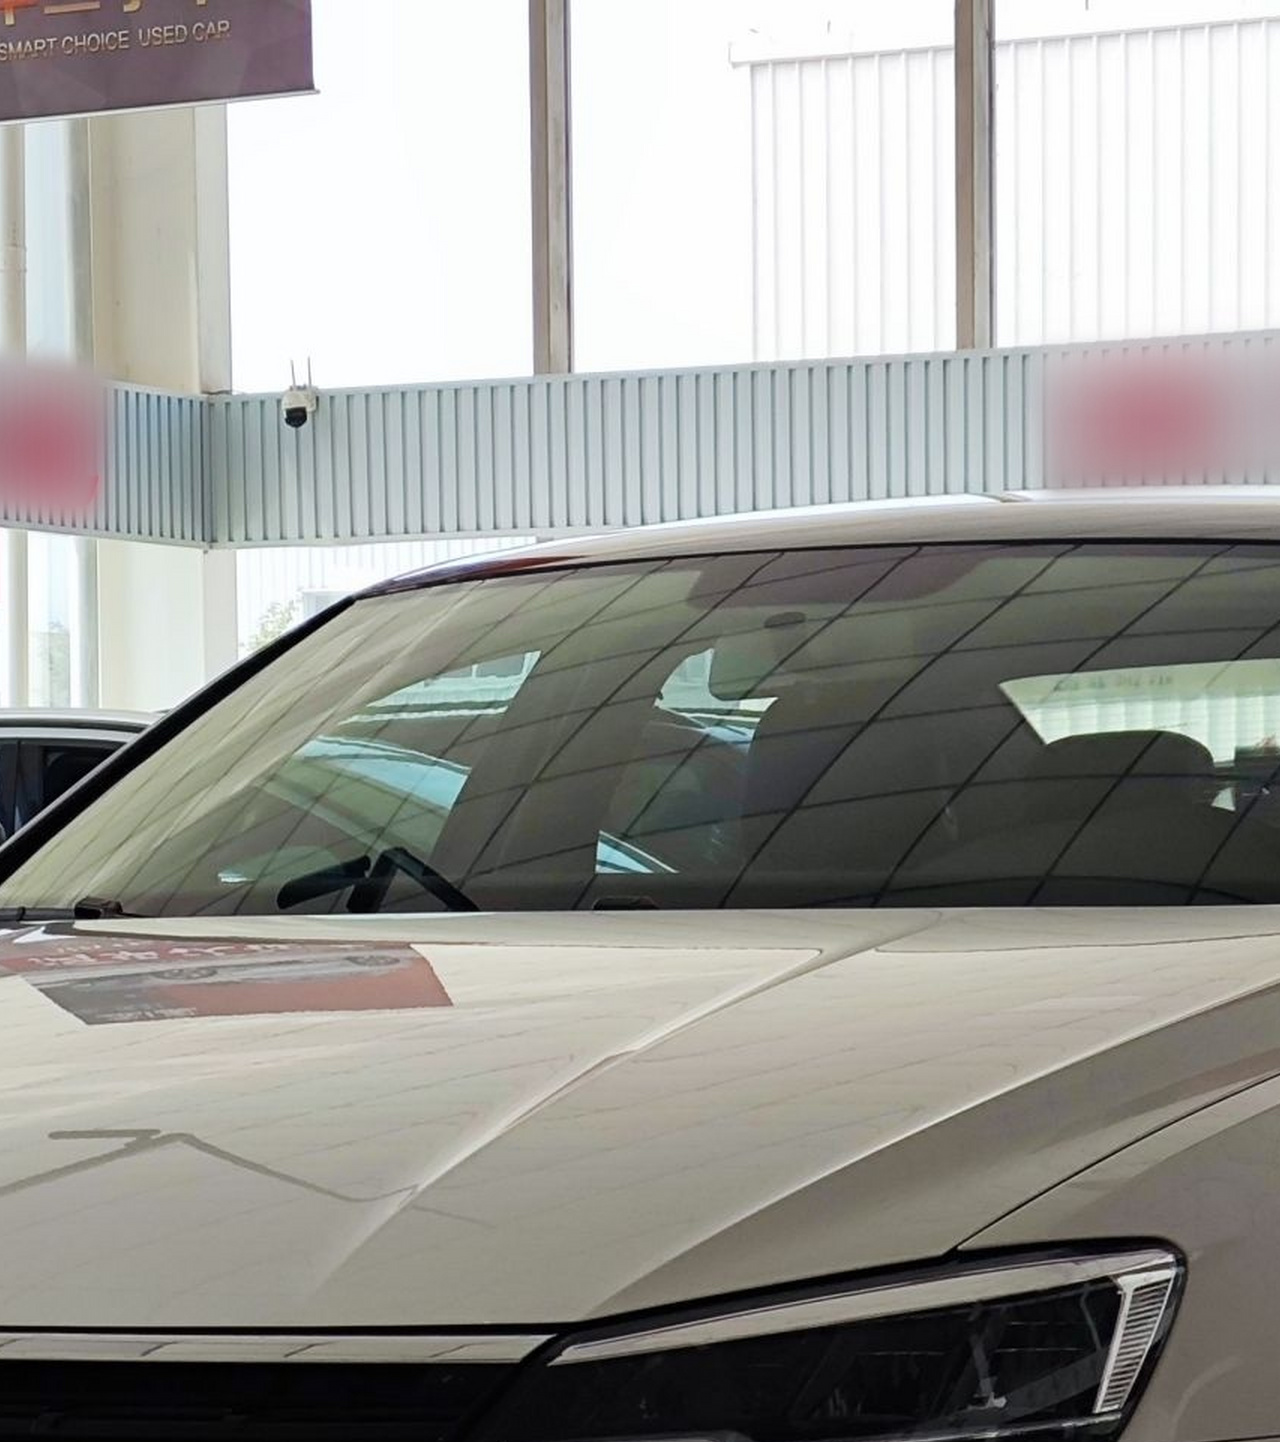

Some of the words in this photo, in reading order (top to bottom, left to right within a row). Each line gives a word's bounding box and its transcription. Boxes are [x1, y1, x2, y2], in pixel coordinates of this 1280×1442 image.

[61, 30, 130, 54] CHOICE
[138, 24, 187, 47] USED
[192, 20, 231, 42] CAR
